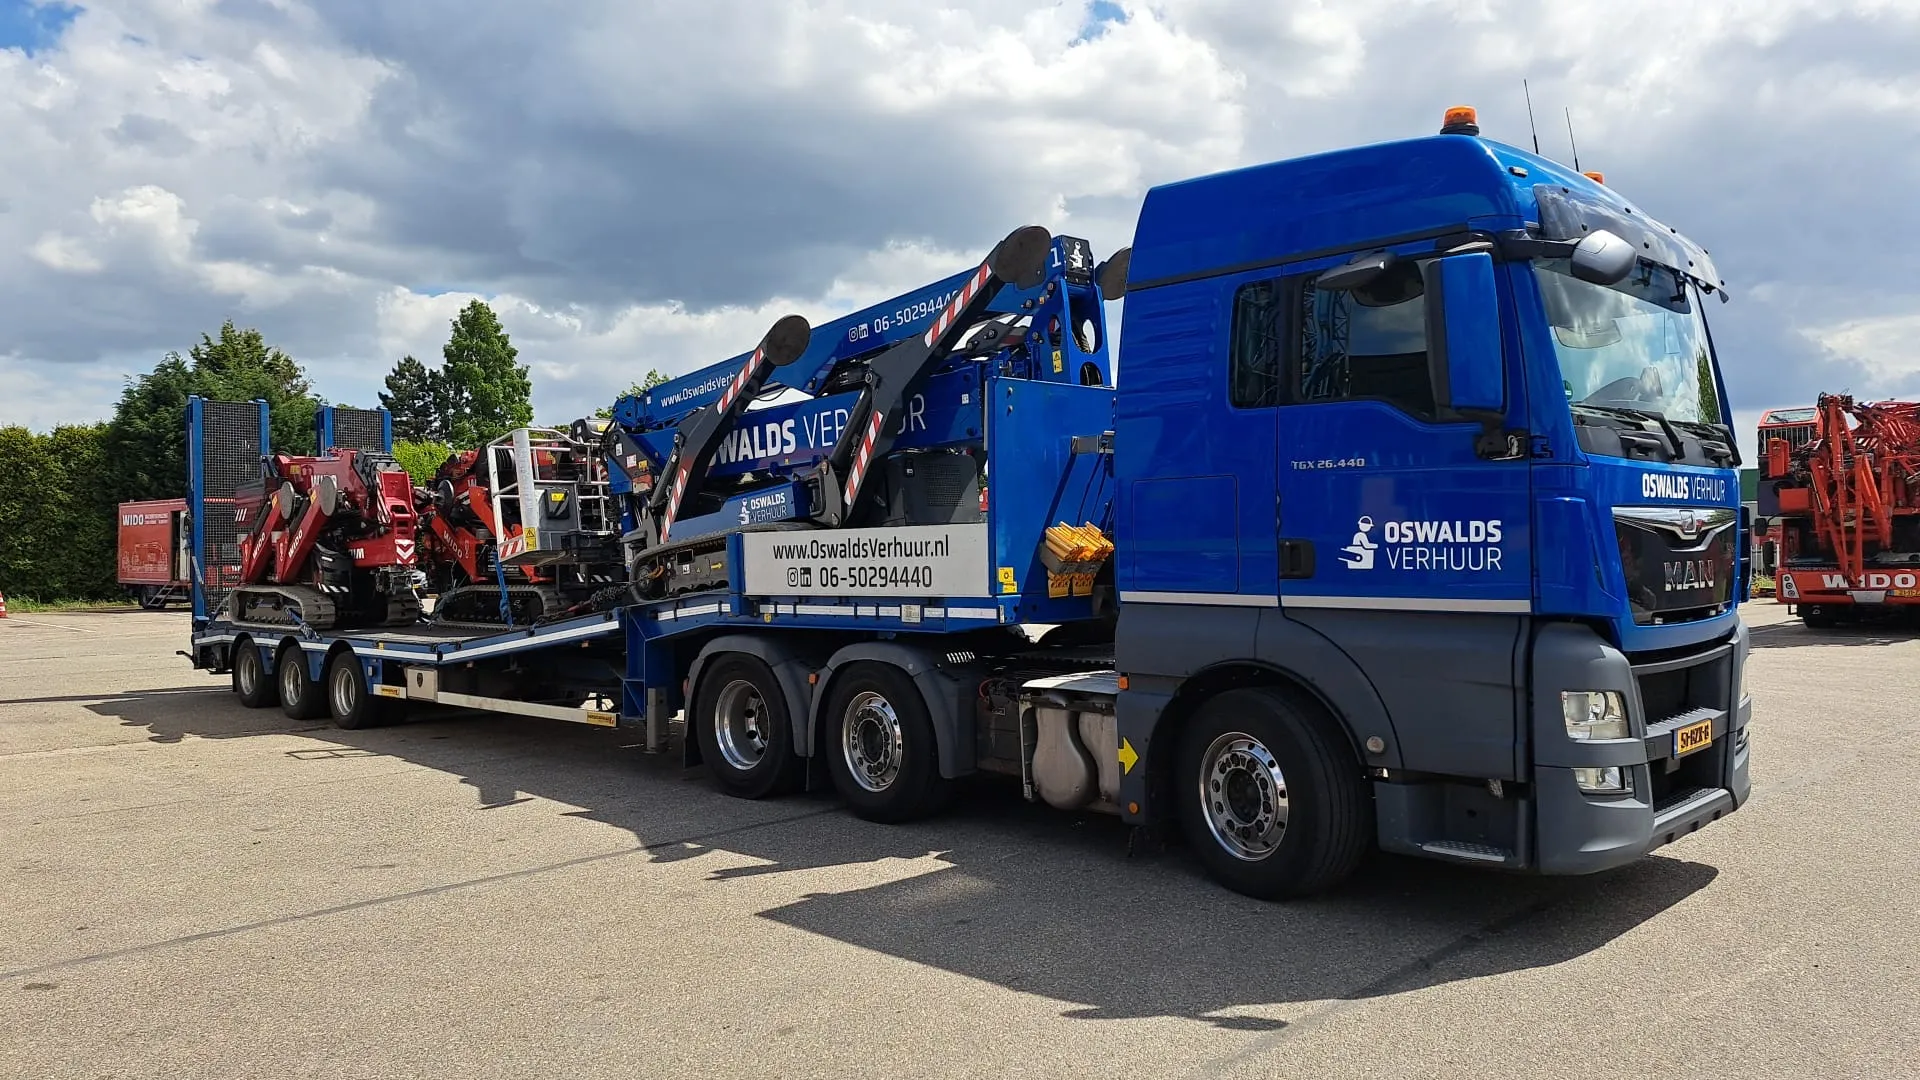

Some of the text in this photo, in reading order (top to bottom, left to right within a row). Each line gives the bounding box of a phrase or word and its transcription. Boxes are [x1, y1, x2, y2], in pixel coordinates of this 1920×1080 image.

[874, 289, 958, 334] 06-5029444
[1291, 458, 1365, 470] TGX 26.440
[1642, 473, 1726, 502] OSWALDS VERHUUR
[750, 492, 786, 510] OSWALDS
[751, 505, 787, 522] VERHUUR
[122, 514, 144, 526] WIDO
[1384, 520, 1502, 543] OSWALDS
[288, 529, 303, 558] WIDO
[443, 530, 463, 559] WIDO
[772, 533, 949, 562] www.OswaldsVerhuur.nl
[1386, 546, 1502, 571] VERHUUR
[820, 565, 933, 588] 06-50294440
[1664, 560, 1714, 592] MAN
